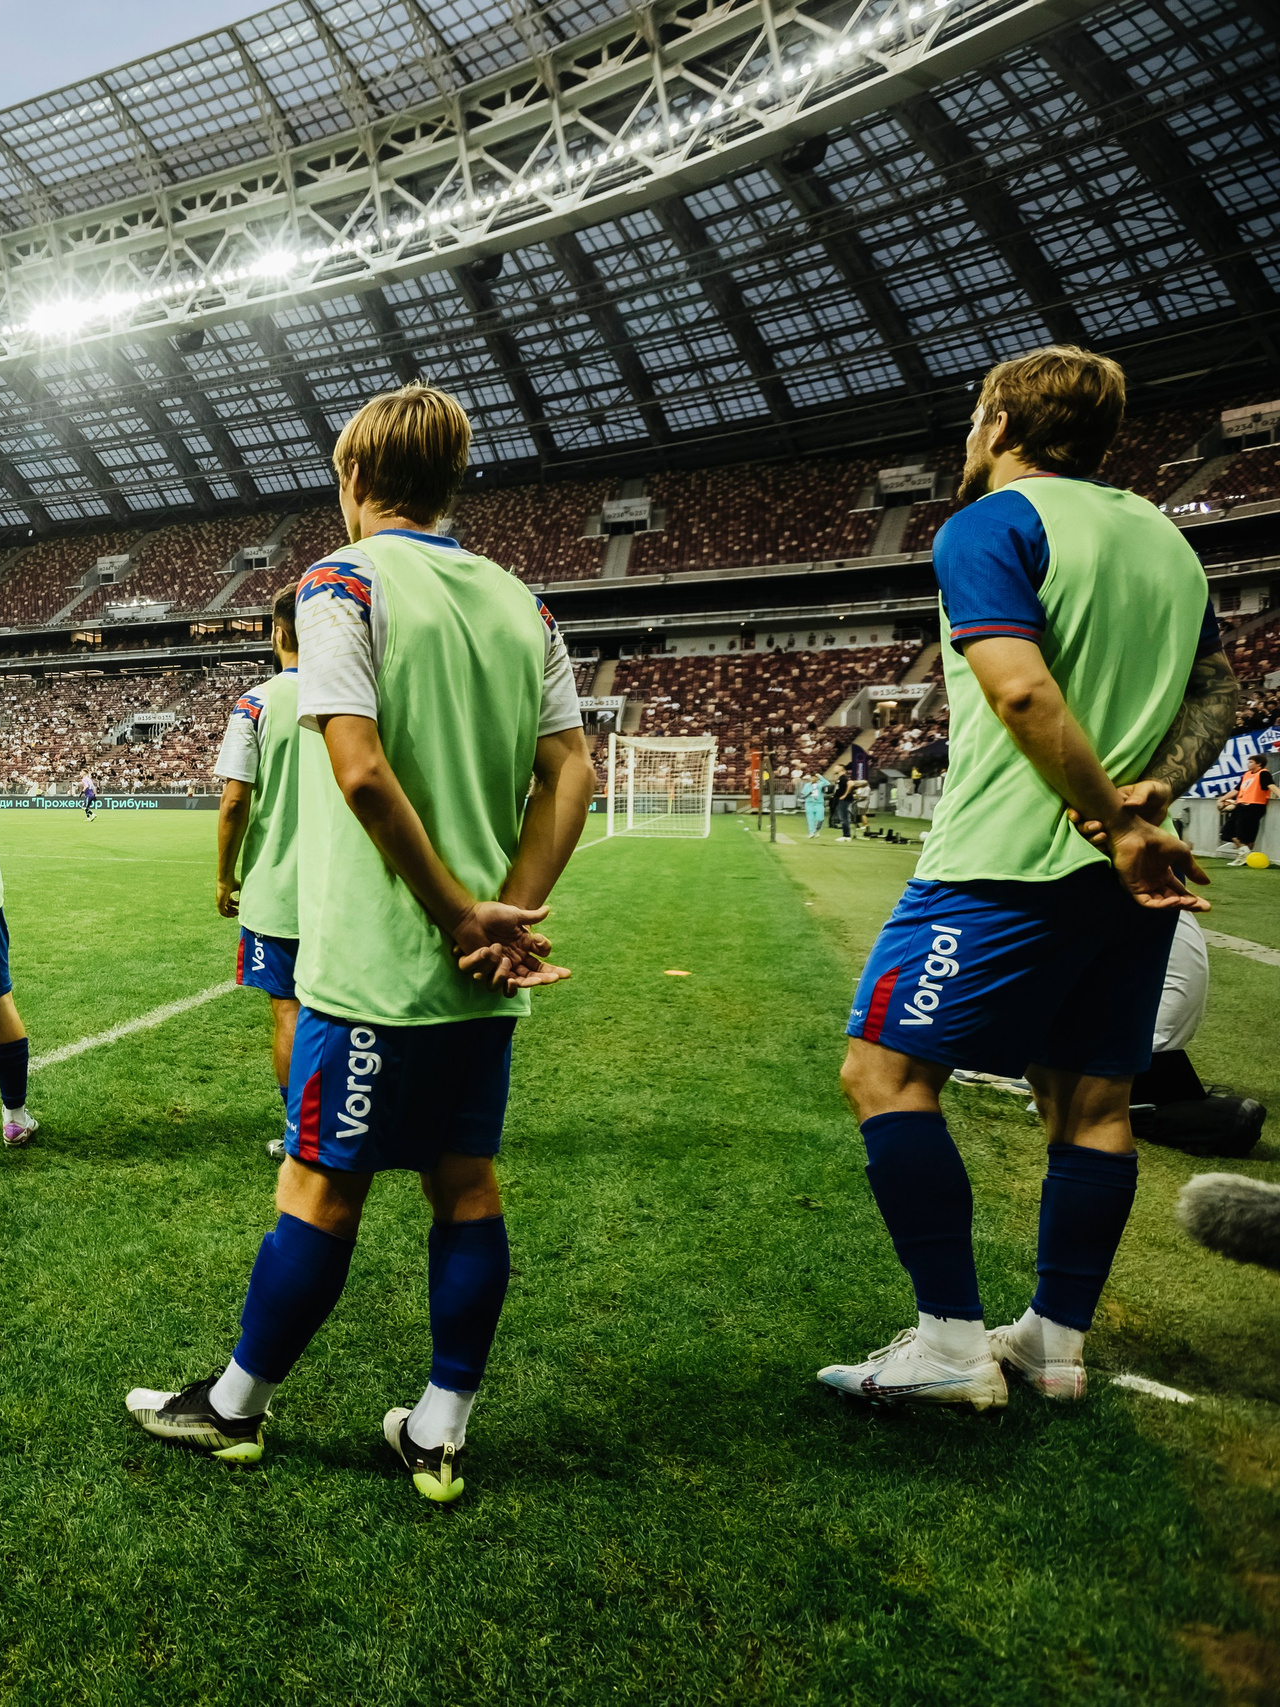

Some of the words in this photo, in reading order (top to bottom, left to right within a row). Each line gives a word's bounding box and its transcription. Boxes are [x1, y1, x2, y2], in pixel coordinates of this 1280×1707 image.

[15, 800, 30, 808] на
[31, 798, 103, 810] "Прожекор
[103, 798, 158, 810] Трибуны
[899, 924, 962, 1025] Vorgol
